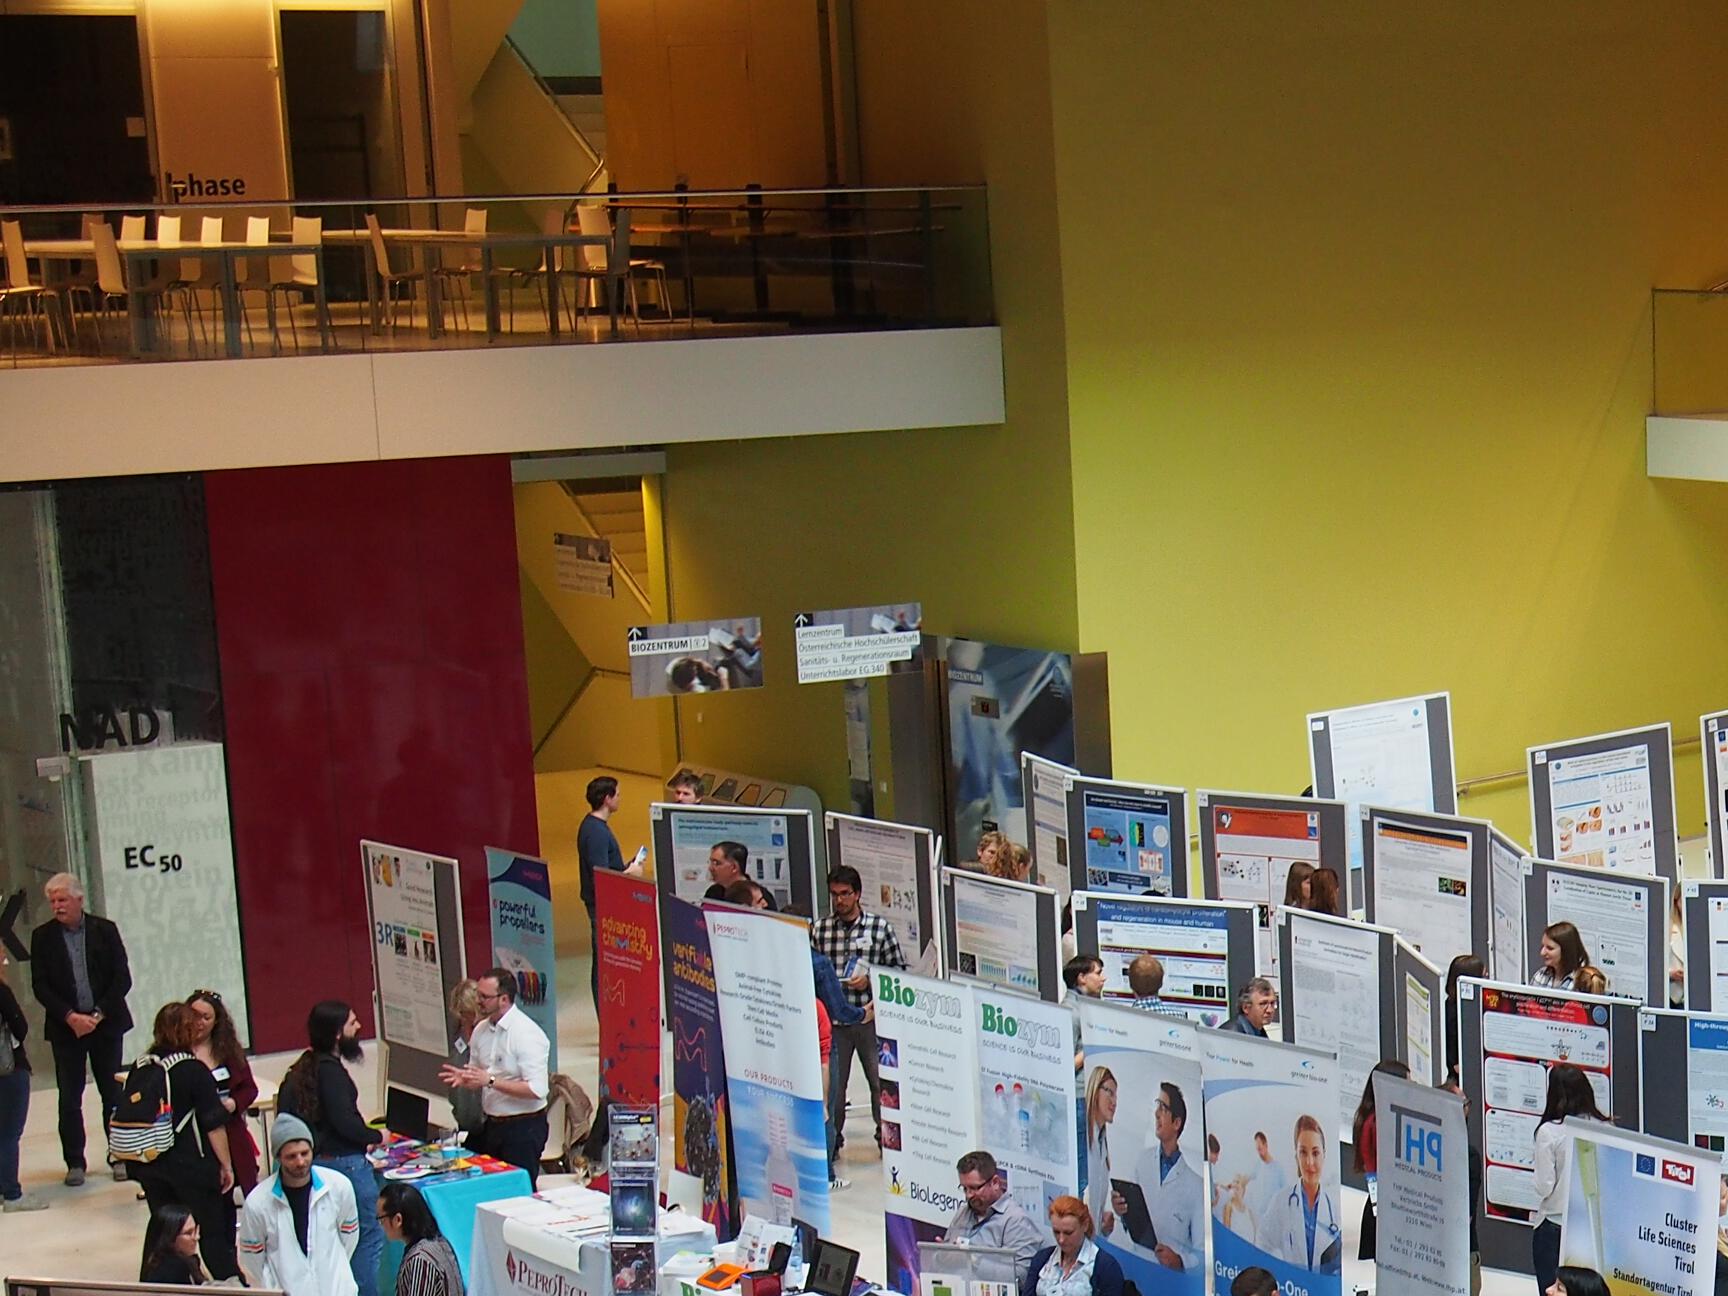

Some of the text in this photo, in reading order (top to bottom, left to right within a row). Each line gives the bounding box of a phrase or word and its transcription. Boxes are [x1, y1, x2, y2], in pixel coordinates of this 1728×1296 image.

[798, 627, 843, 639] Lernzentrum
[854, 633, 918, 649] Hochschülerschaft
[631, 639, 689, 653] BIOZENTRUM
[800, 666, 857, 681] Unterrichtslabor
[124, 845, 182, 872] EC 50
[499, 900, 536, 919] powerful
[376, 921, 394, 947] 3R
[878, 972, 962, 1019] Biozym
[879, 1009, 906, 1022] SCIENCE
[982, 1003, 1061, 1049] Biozym
[982, 1038, 1008, 1053] SCIENCE
[744, 1068, 793, 1090] OUR PRODUCTS
[1665, 1212, 1698, 1235] Cluster
[1638, 1225, 1696, 1254] Life Sciences
[1674, 1255, 1695, 1275] Tirol
[1613, 1268, 1676, 1294] Standortagentur
